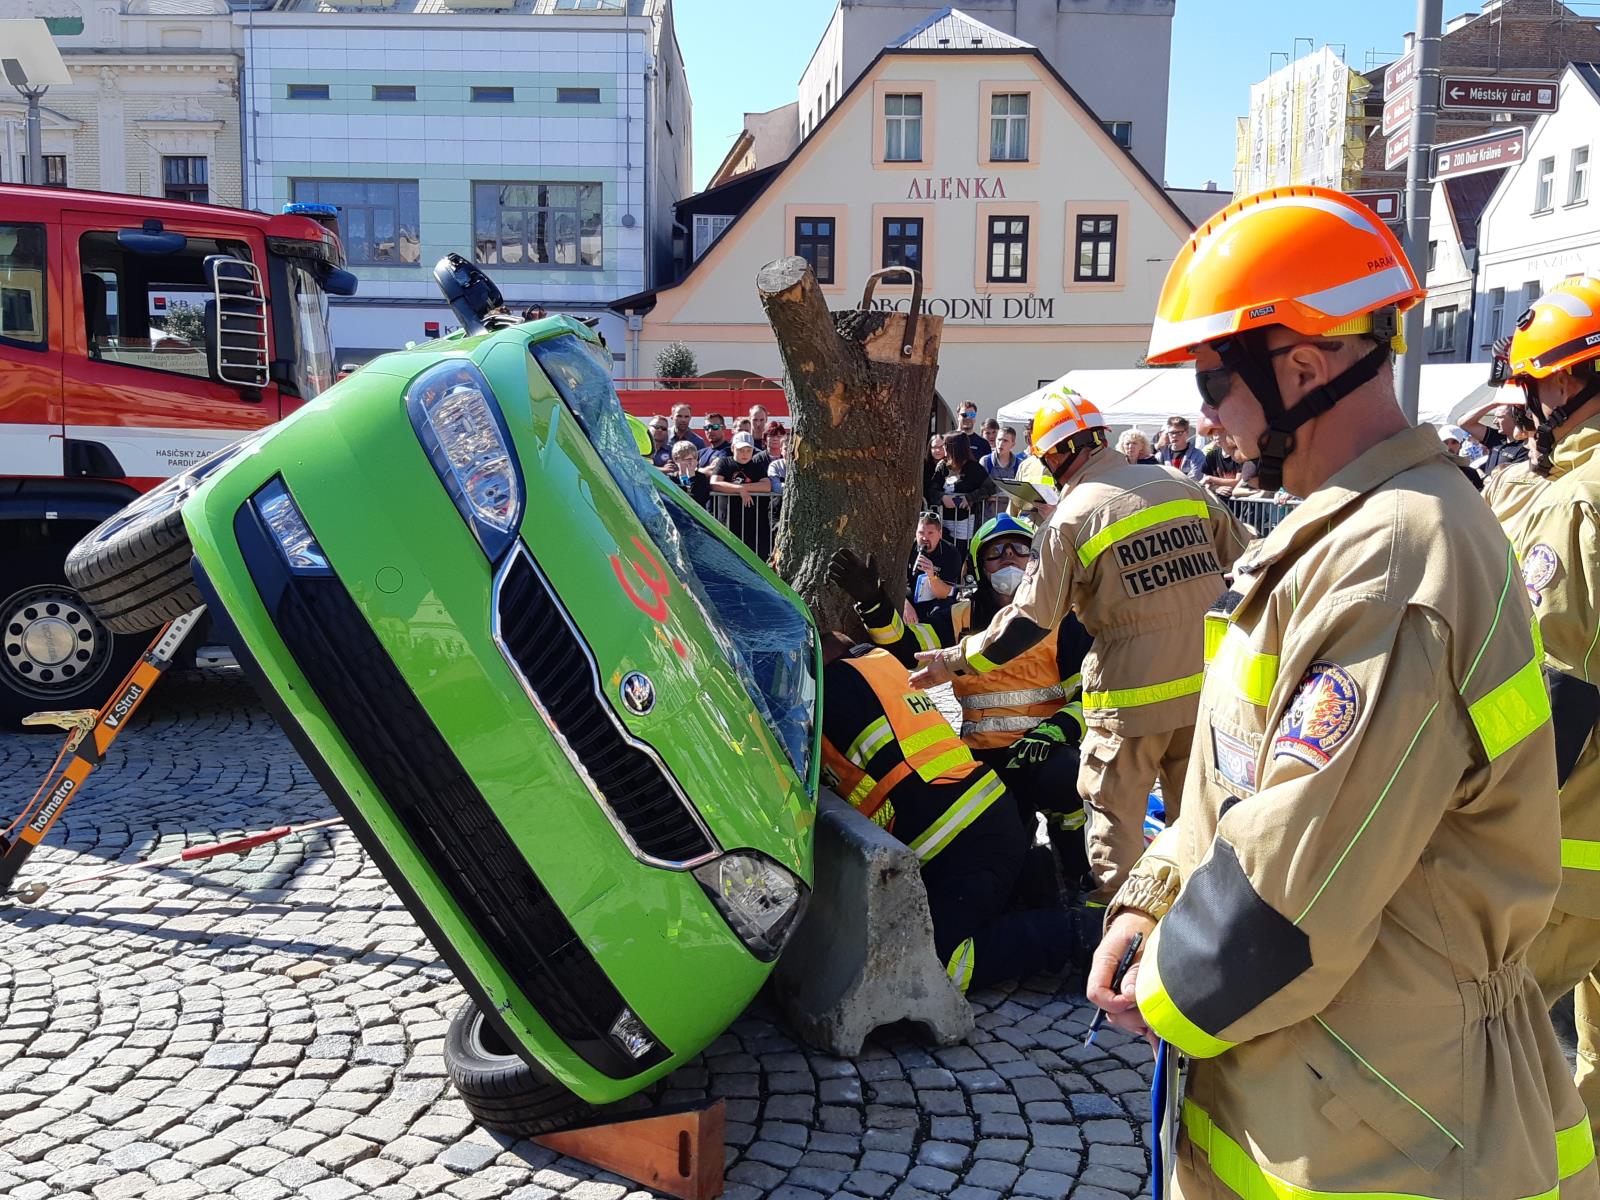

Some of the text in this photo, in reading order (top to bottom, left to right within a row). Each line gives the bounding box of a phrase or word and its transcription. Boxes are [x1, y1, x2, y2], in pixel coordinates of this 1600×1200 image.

[1327, 59, 1341, 129] weber
[1470, 87, 1531, 103] Městský úřad
[1307, 77, 1319, 151] weber
[1453, 145, 1502, 167] ZOO Dvůr Králové
[906, 177, 1008, 200] ALENKA
[1002, 292, 1055, 319] DŮM
[1250, 306, 1275, 318] MSA
[156, 449, 216, 458] HASIČSKÝ ZÁC
[1117, 519, 1208, 566] ROZHODČÍ
[1125, 552, 1220, 594] TECHNIKA
[105, 685, 142, 727] V-Strut
[30, 780, 74, 832] holmatro
